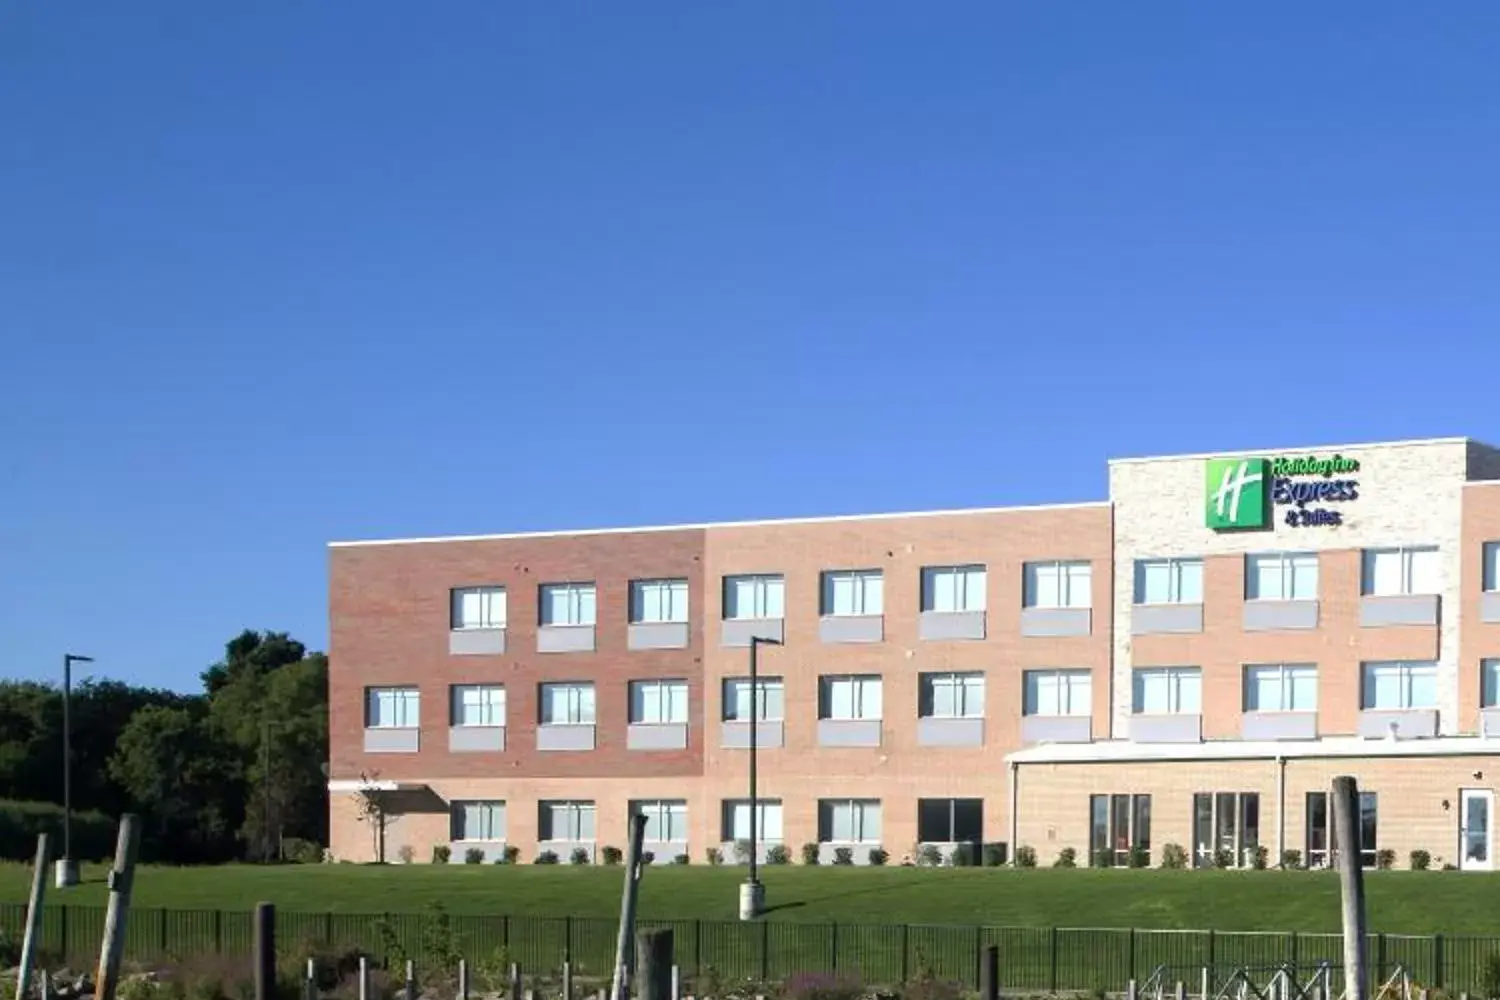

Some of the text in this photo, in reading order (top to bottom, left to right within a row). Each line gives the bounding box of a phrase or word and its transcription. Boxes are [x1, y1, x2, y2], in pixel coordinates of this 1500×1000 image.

[1271, 456, 1332, 477] Holiday
[1271, 478, 1359, 507] Express
[1285, 510, 1300, 527] &
